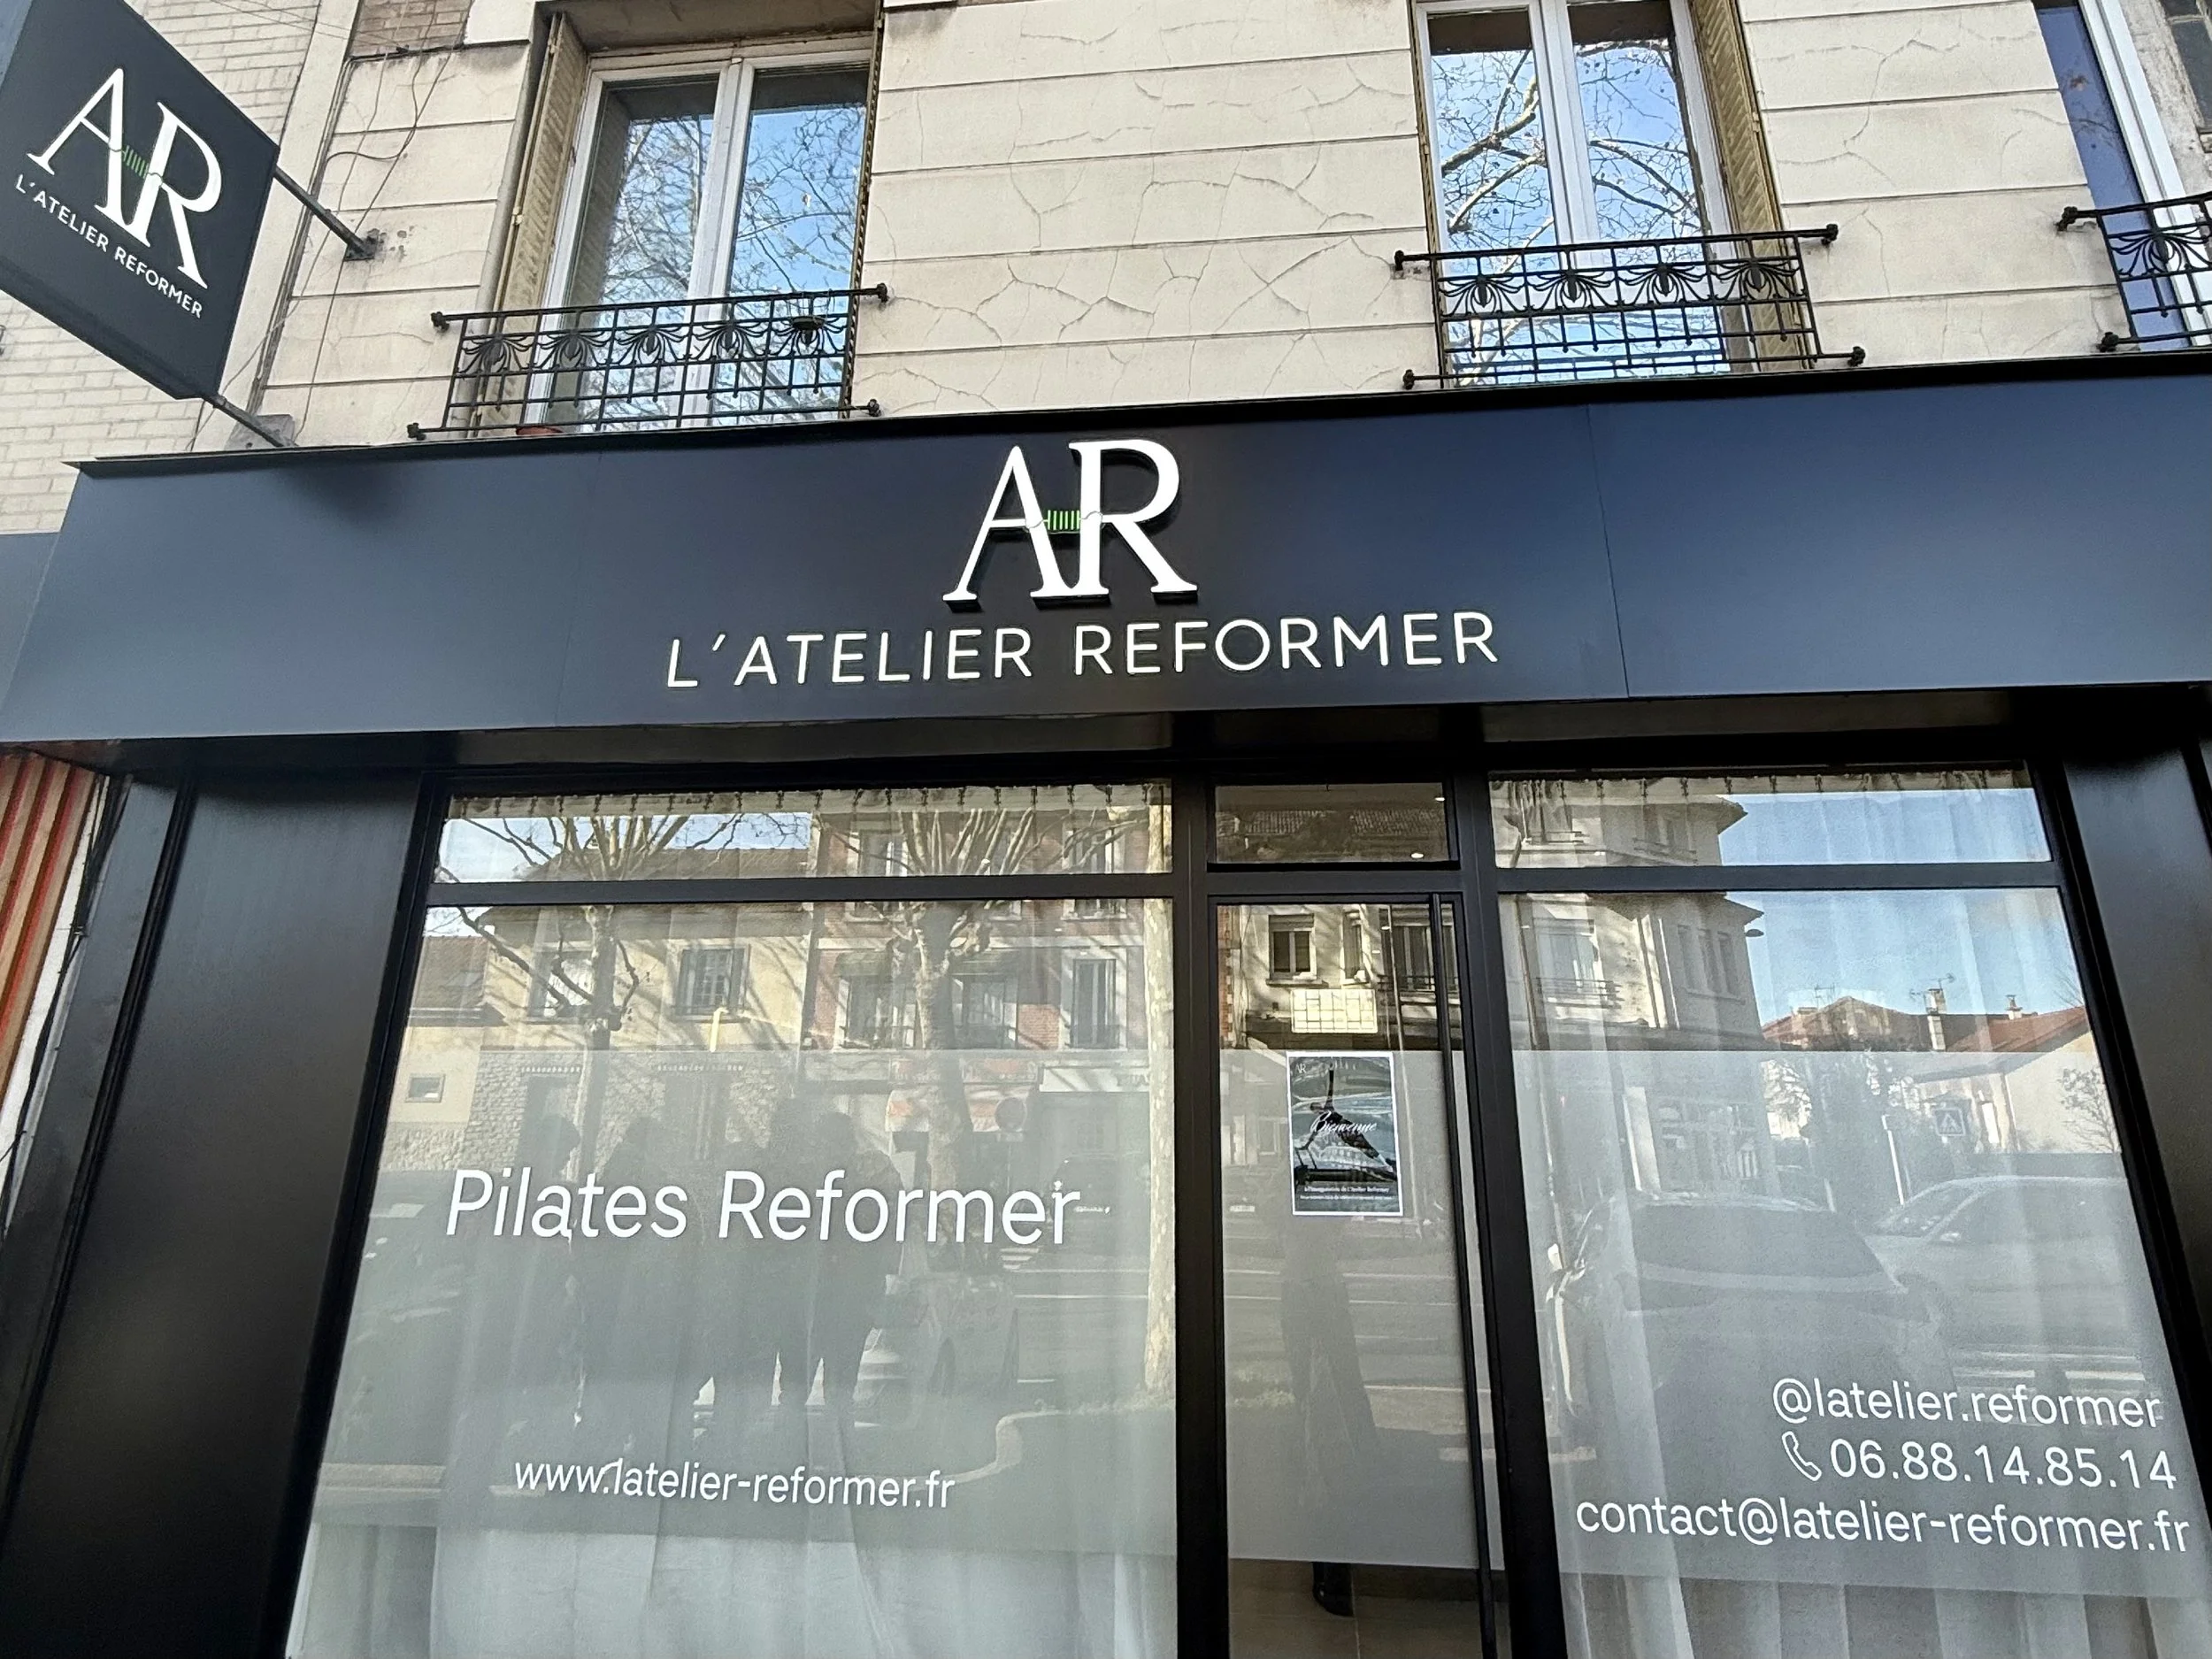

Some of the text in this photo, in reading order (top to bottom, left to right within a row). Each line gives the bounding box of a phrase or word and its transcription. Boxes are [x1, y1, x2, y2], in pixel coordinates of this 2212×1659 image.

[26, 67, 222, 289] AR
[114, 245, 203, 319] REFORMER
[941, 438, 1199, 603] AR
[666, 611, 1499, 688] L'ATELIER REFORMER
[445, 1166, 1082, 1245] Pilates Reformer
[1771, 1377, 2162, 1429] @latelier.reformer
[514, 1458, 956, 1509] www.latelier-reformer.fr
[1829, 1437, 2177, 1490] 06.88.14.85.14
[1575, 1496, 2191, 1553] contact@latelier-reformer.fr
